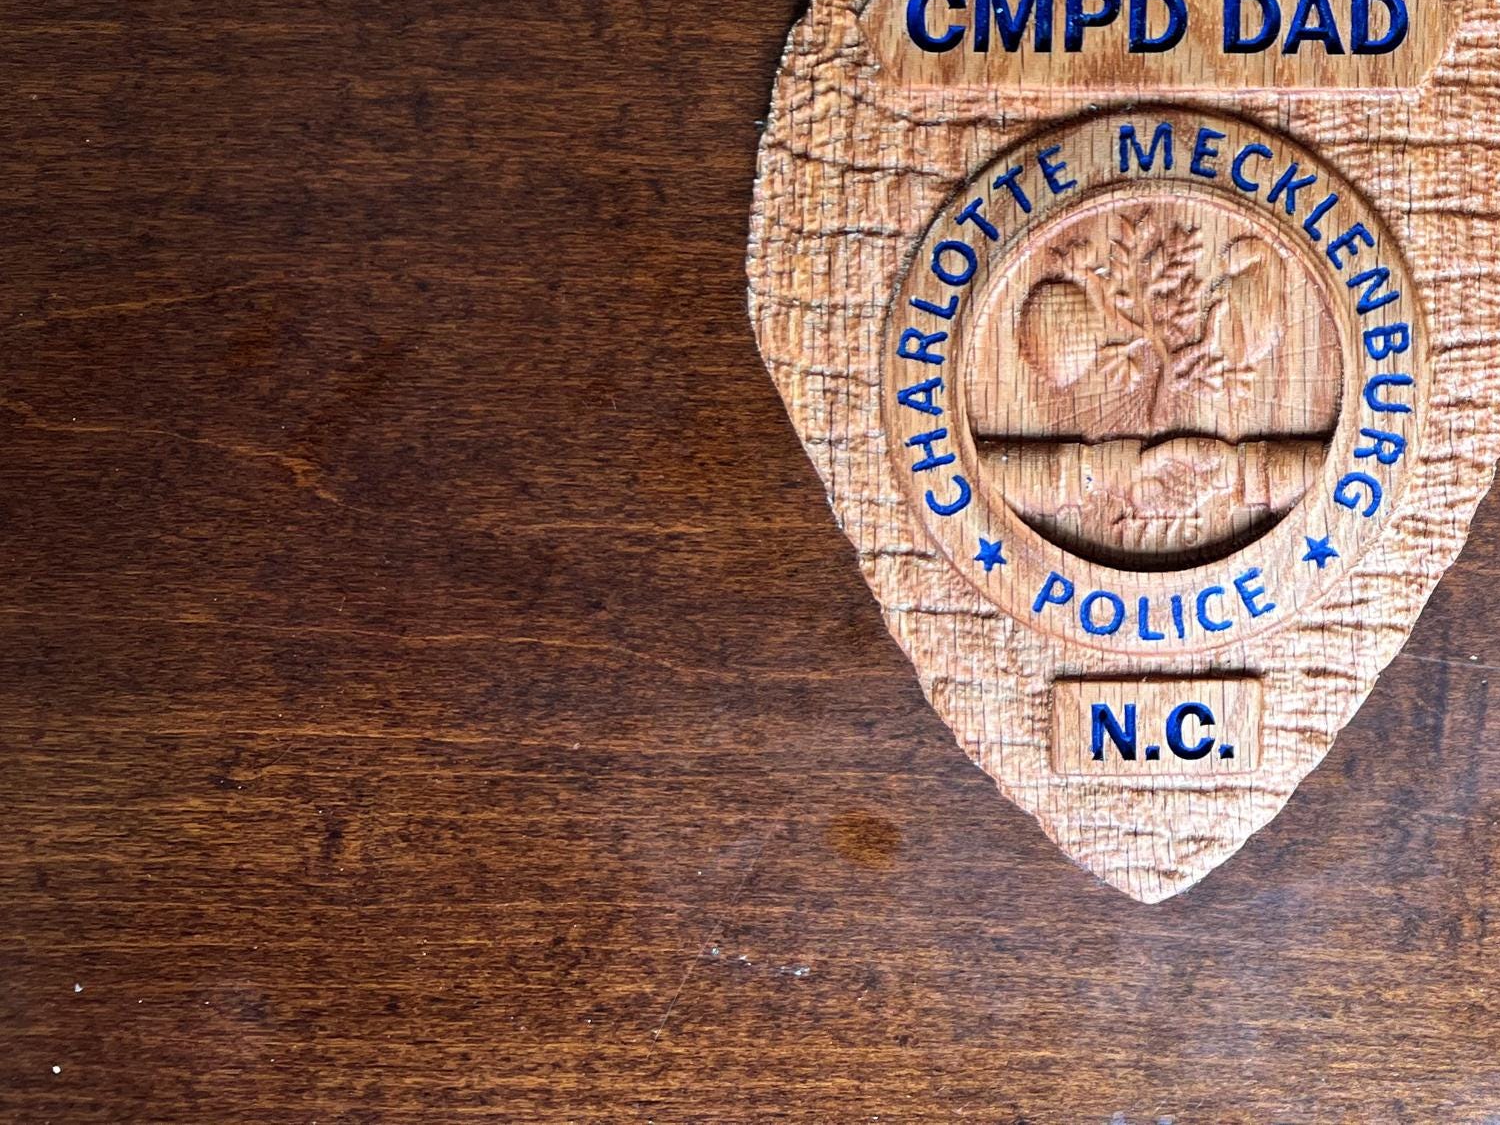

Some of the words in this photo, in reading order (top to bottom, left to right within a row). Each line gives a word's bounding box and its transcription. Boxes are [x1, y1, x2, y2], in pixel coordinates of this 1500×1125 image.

[895, 144, 1078, 518] CHARLOTTE
[1117, 121, 1416, 521] MECKLENBURG
[1030, 565, 1280, 644] POLICE
[1087, 700, 1239, 763] N.C.
